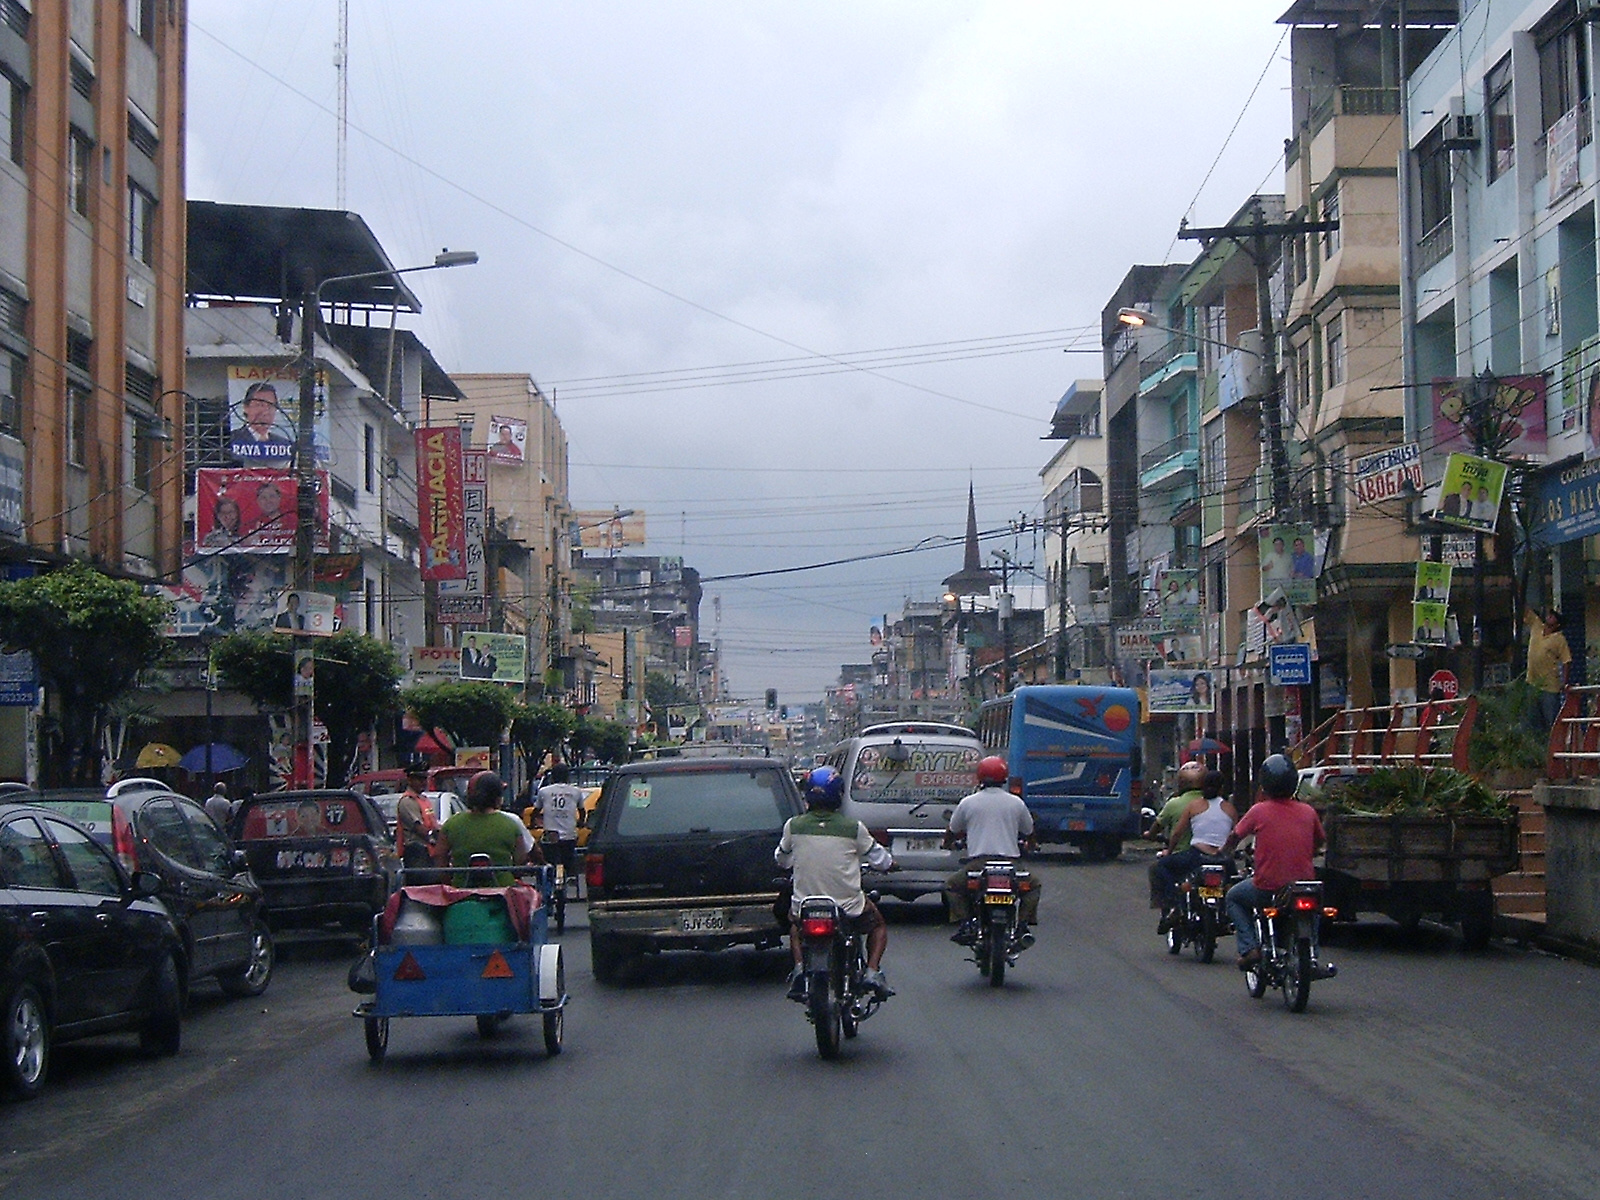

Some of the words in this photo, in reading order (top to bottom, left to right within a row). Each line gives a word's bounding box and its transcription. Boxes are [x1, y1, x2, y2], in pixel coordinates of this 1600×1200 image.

[427, 432, 449, 565] FARMACIA
[1431, 680, 1456, 693] PARE
[920, 774, 974, 785] EXPRESS
[552, 797, 566, 809] 10
[326, 810, 344, 823] 17
